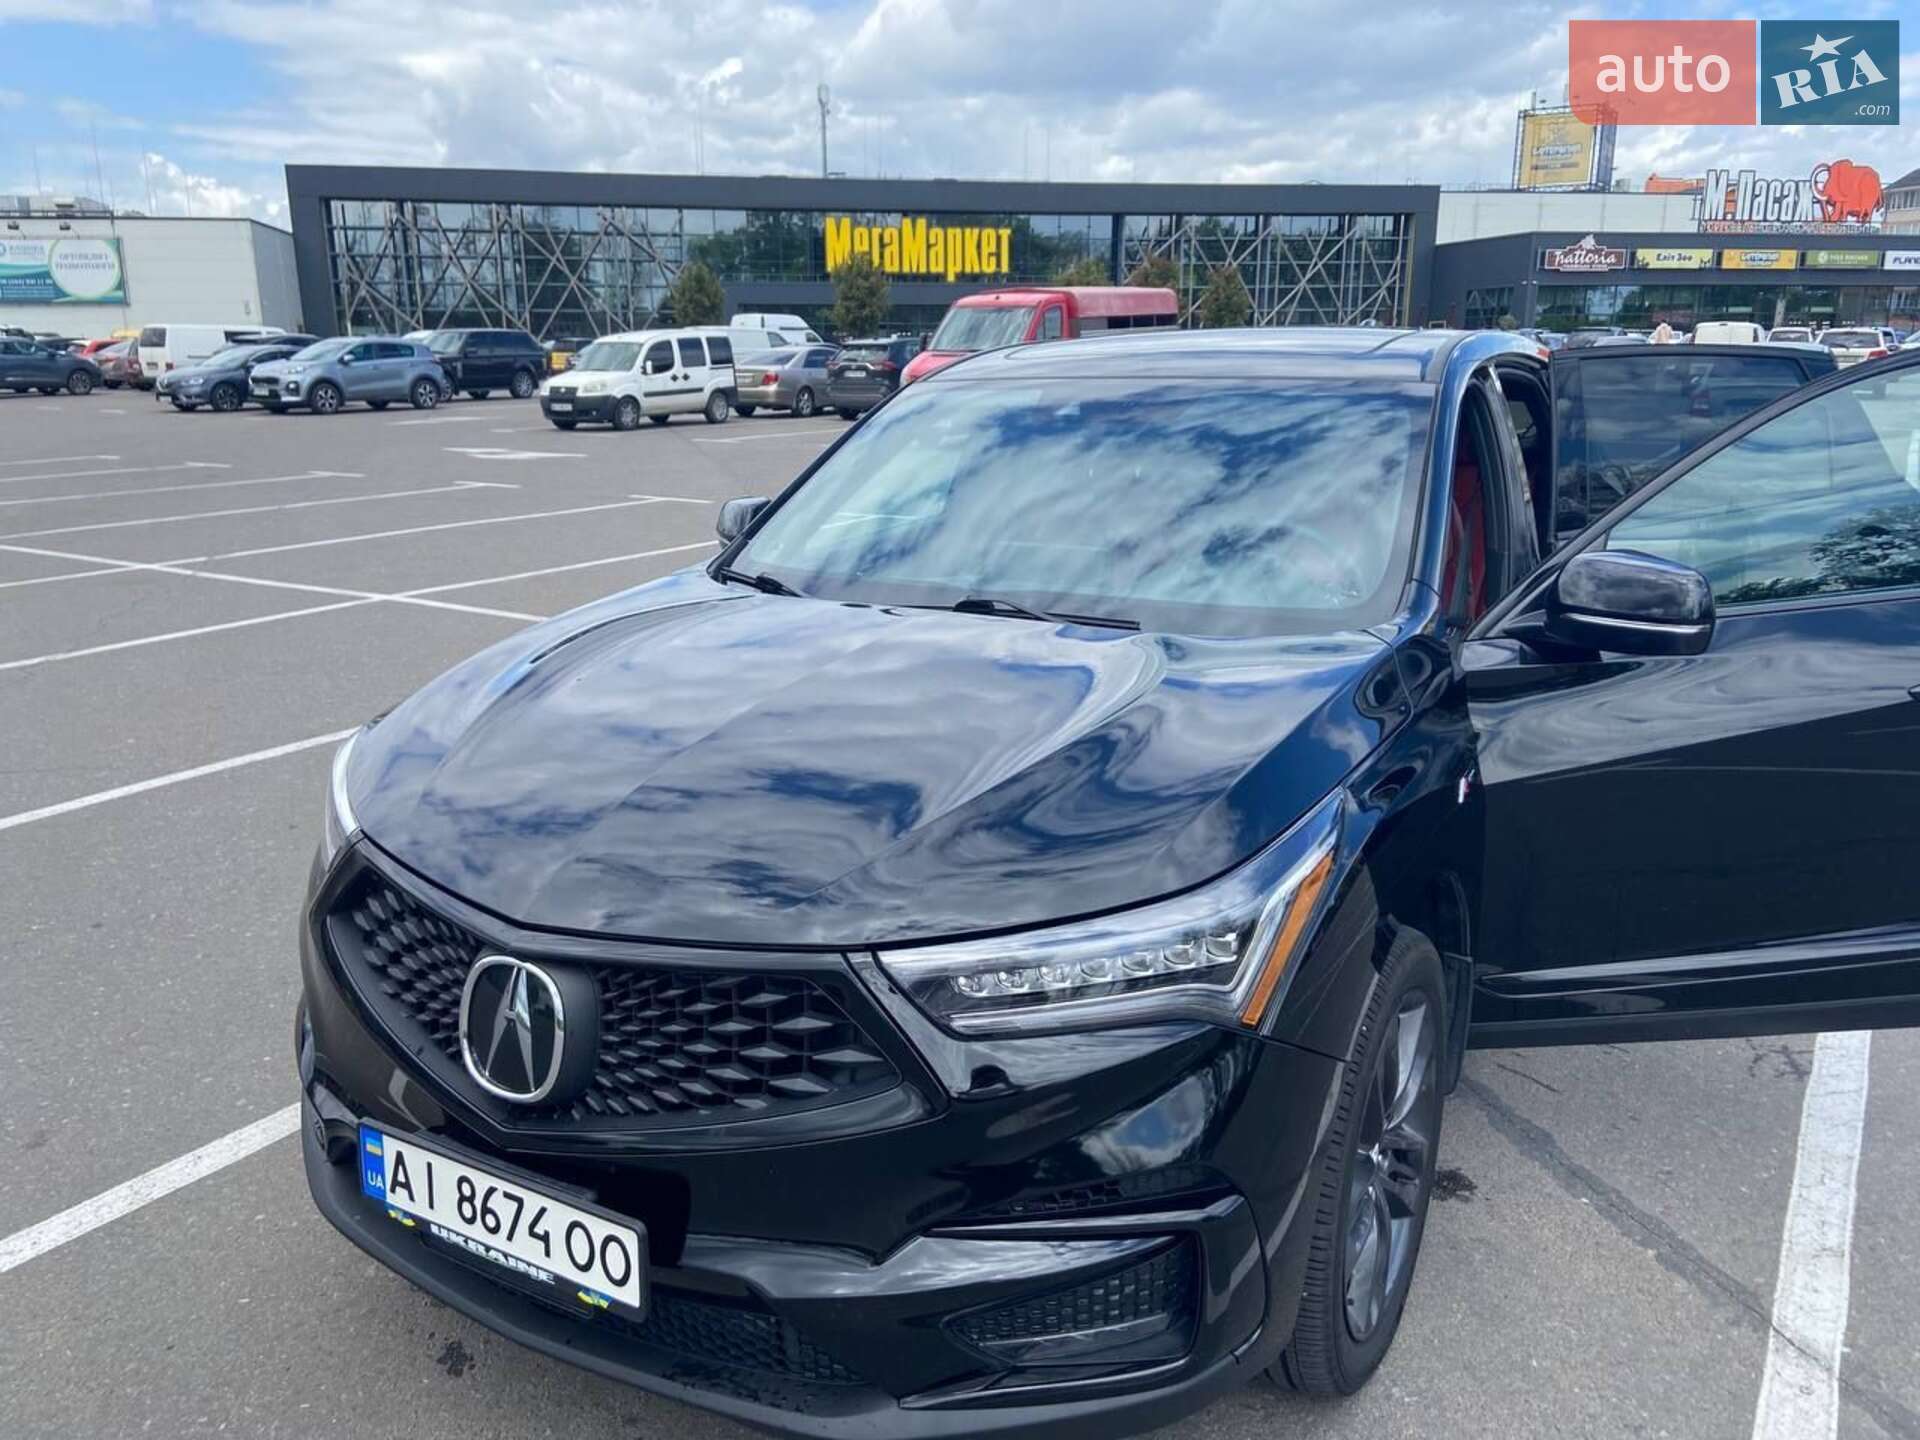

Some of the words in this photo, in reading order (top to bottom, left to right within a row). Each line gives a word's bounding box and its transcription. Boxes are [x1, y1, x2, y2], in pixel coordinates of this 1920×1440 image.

[824, 216, 1012, 282] МегаМаркет
[1554, 249, 1617, 266] Trattoria
[367, 1171, 385, 1190] UA
[389, 1150, 434, 1210] AI
[456, 1175, 551, 1259] 8674
[430, 1223, 556, 1285] UKRAINE
